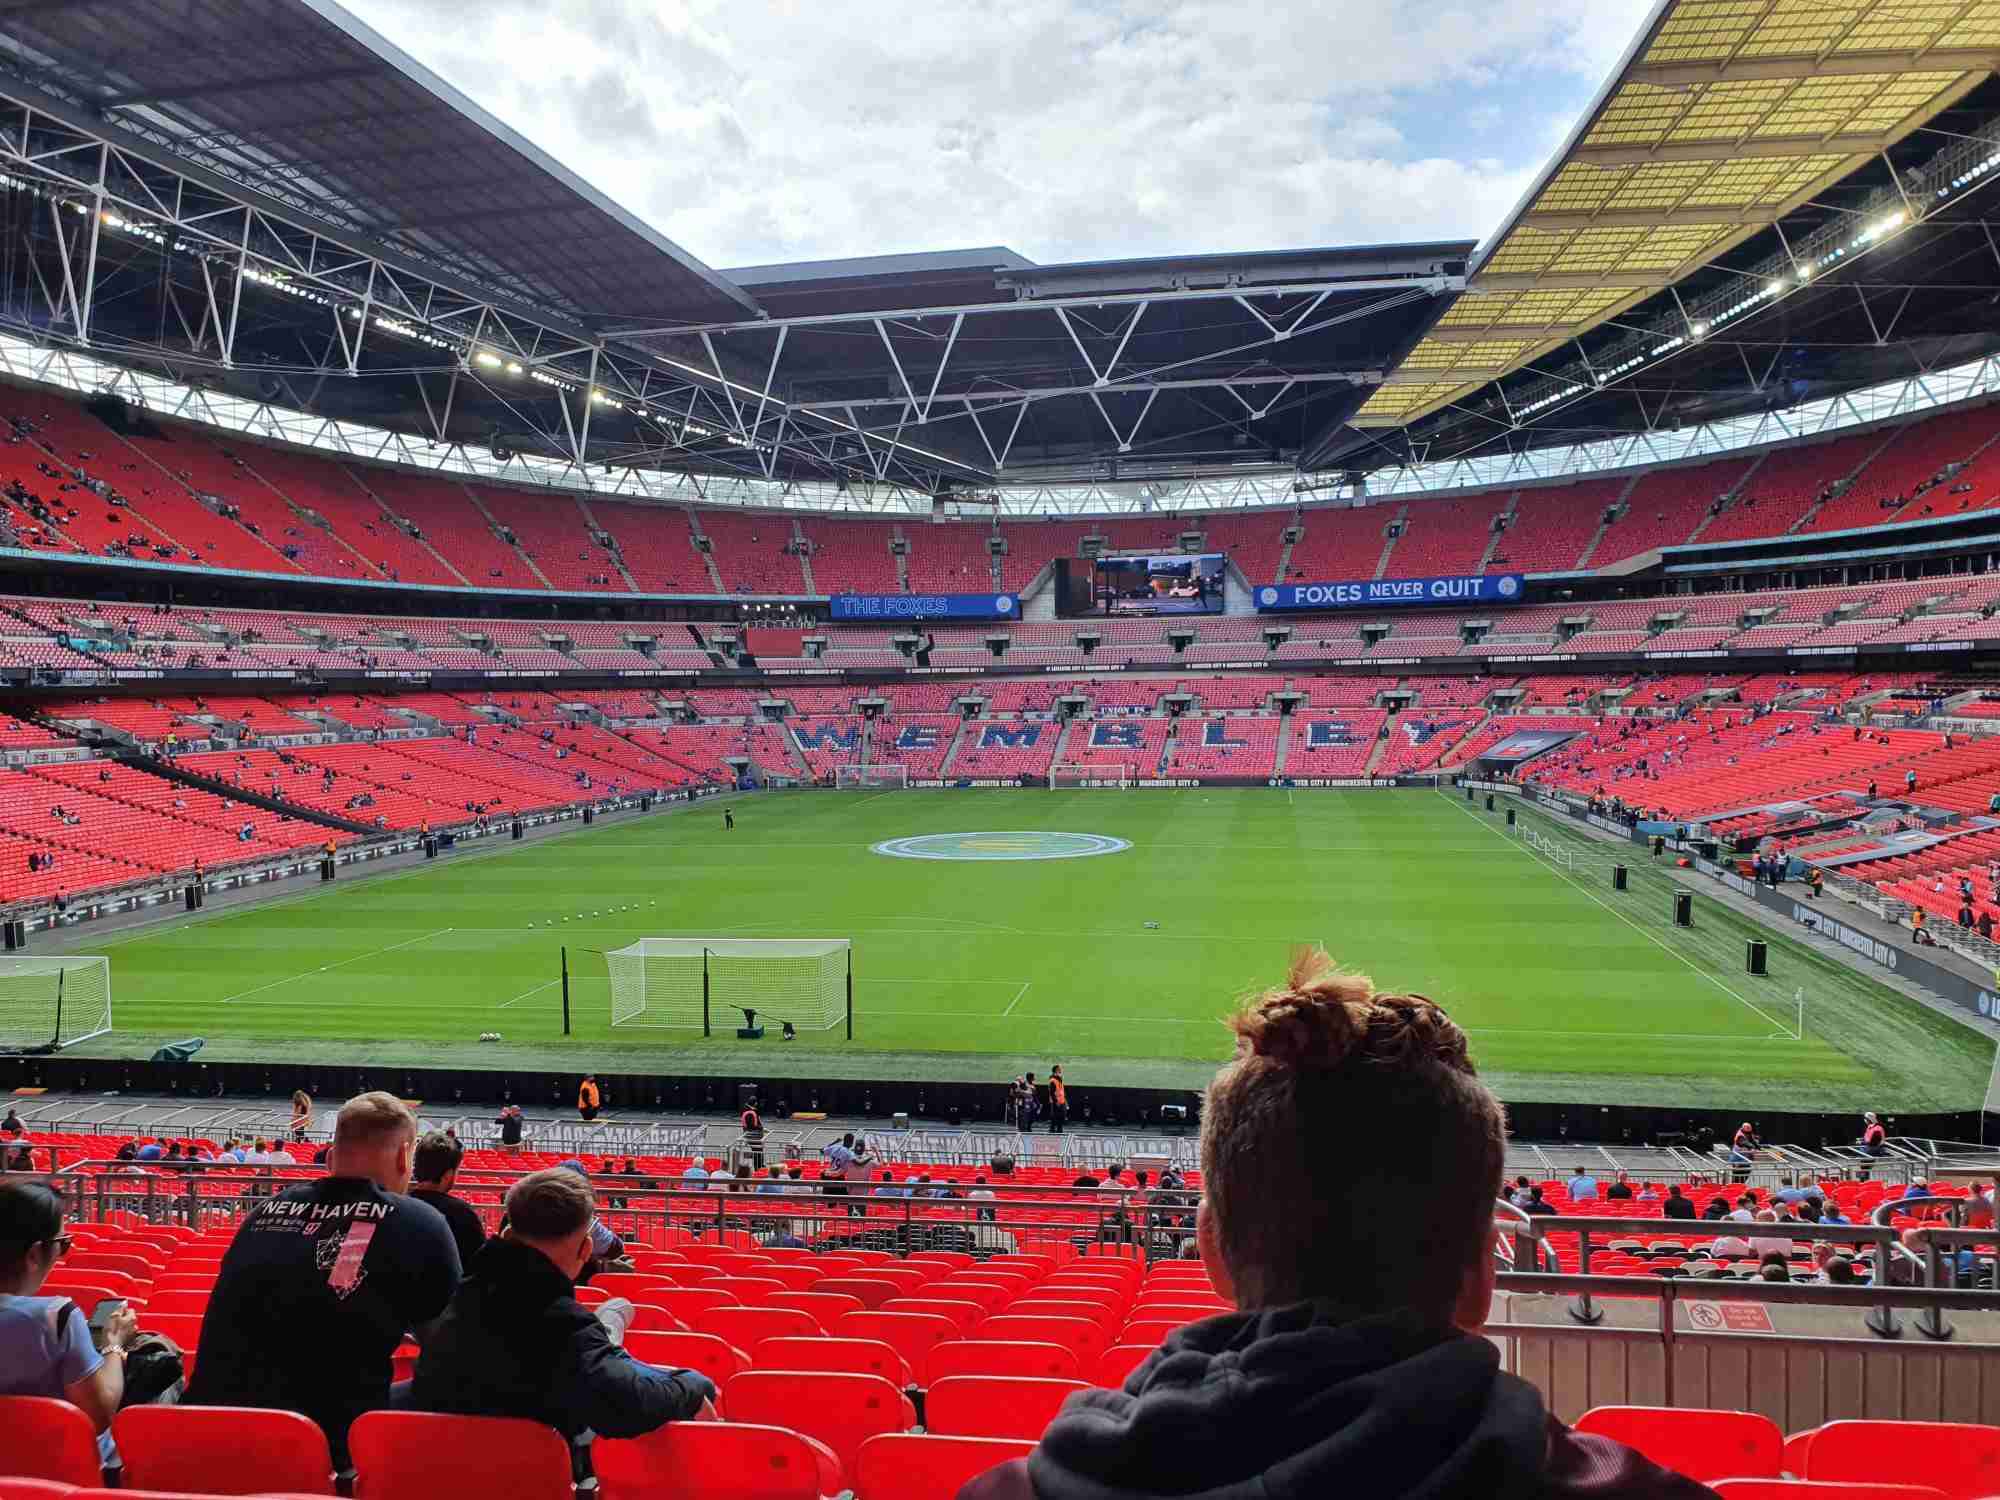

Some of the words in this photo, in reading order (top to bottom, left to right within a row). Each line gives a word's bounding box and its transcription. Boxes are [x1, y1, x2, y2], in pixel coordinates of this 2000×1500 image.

[1295, 584, 1362, 604] FOXES
[1369, 582, 1424, 597] NEVER
[1430, 579, 1484, 598] QUIT
[841, 597, 880, 614] THE
[885, 597, 948, 614] FOXES
